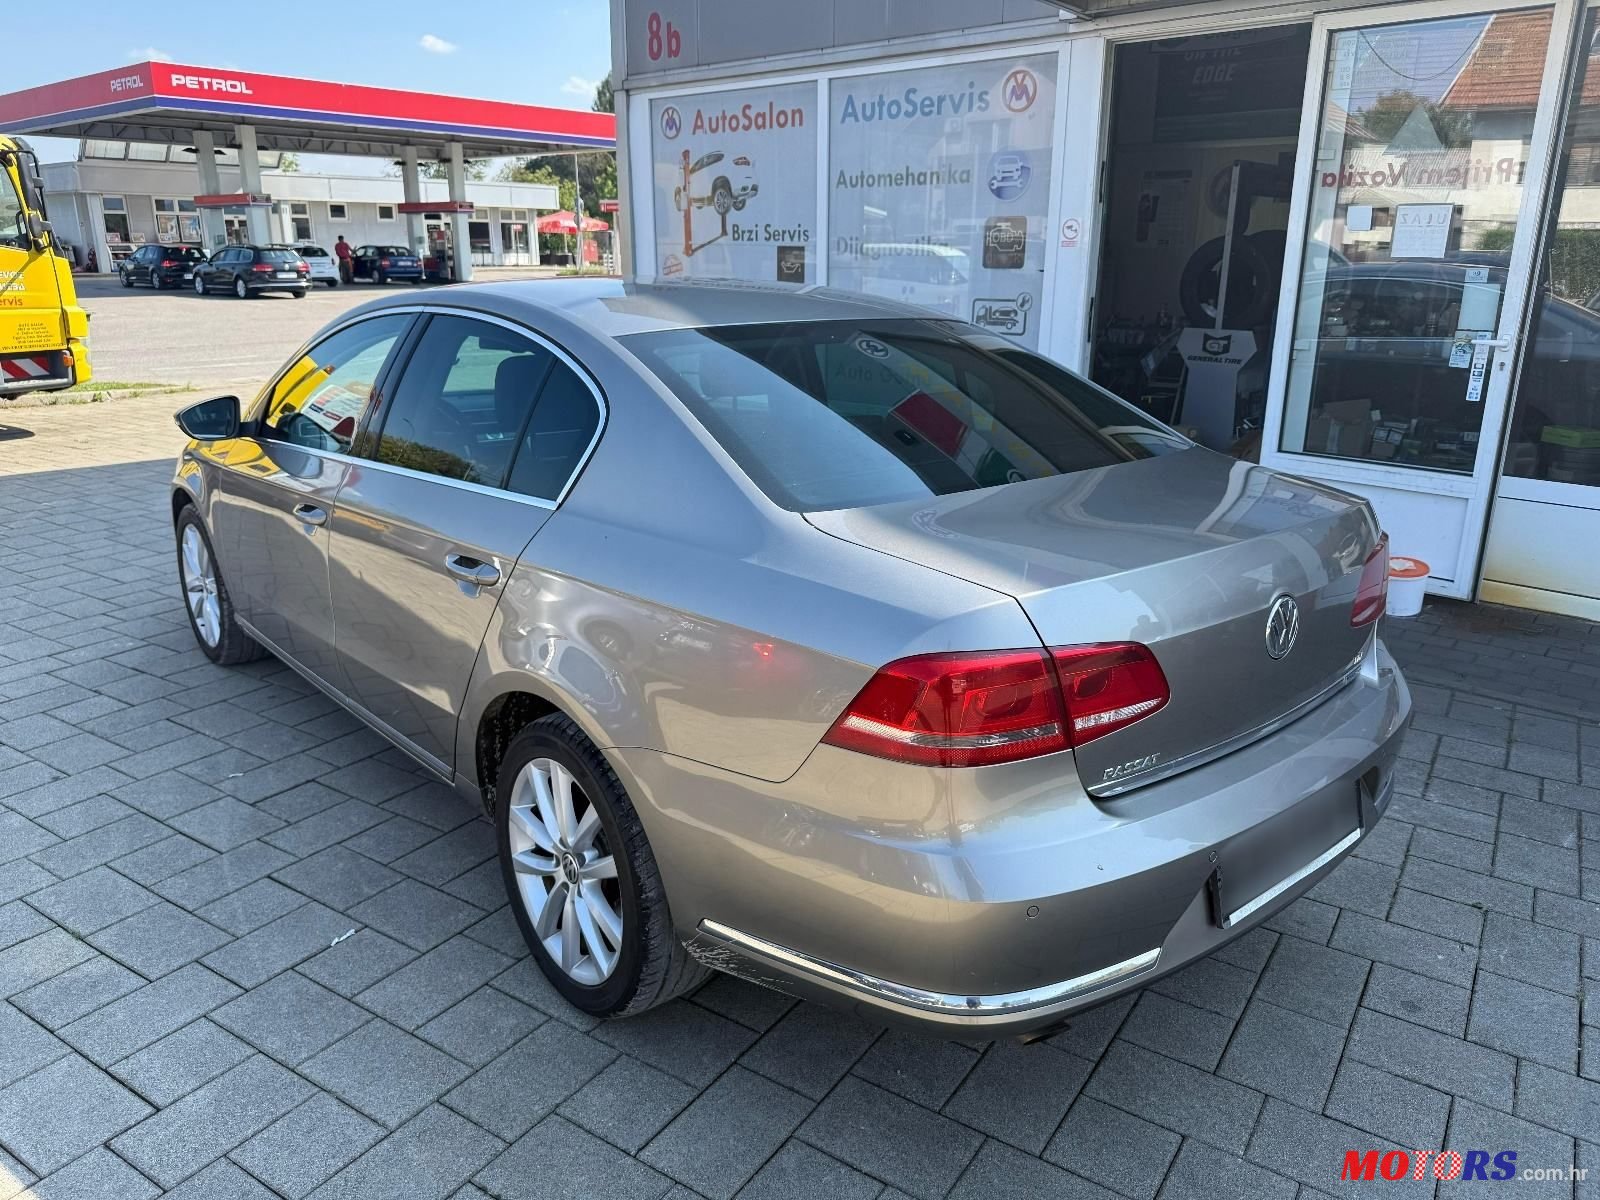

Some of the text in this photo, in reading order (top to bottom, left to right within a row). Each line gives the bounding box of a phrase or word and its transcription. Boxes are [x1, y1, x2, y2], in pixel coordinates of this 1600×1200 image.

[110, 75, 143, 92] PETROL
[1193, 64, 1237, 83] EDGE
[171, 74, 253, 94] PETROL
[840, 81, 990, 124] AutoServis
[692, 102, 804, 135] AutoSalon
[836, 165, 972, 189] Automehanika
[732, 223, 810, 242] Brzi Servis
[1187, 354, 1223, 363] GENERAL
[1103, 752, 1161, 780] PASSAT
